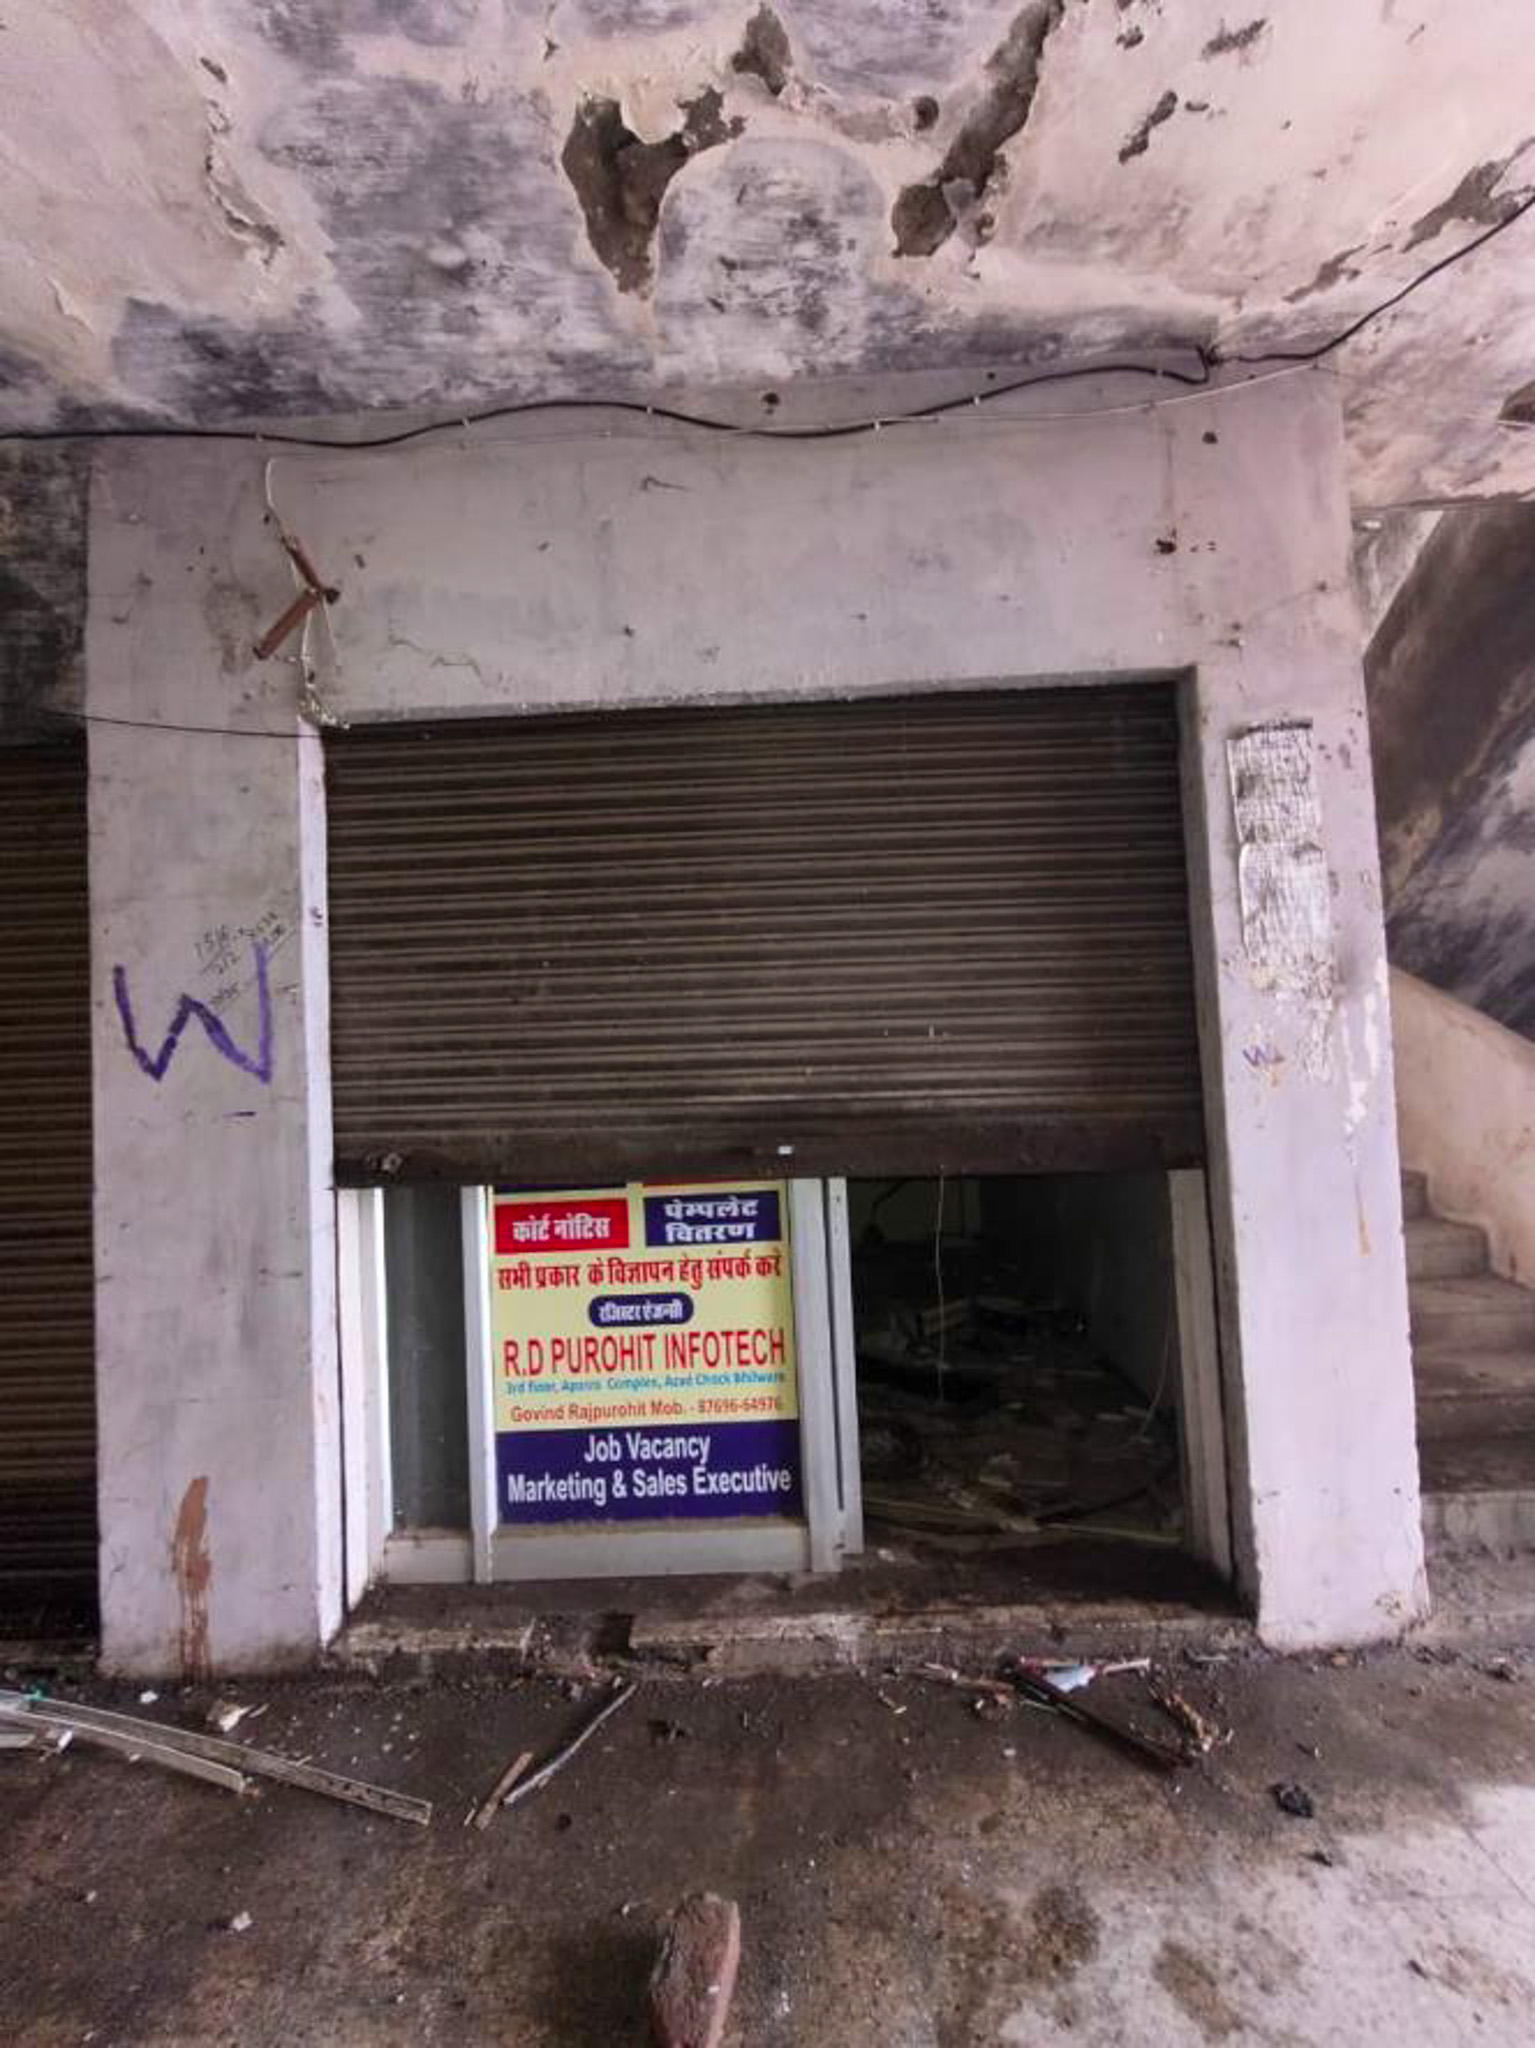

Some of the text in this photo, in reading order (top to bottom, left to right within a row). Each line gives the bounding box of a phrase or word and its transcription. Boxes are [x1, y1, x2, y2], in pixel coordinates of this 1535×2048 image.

[665, 1222, 755, 1243] वितरण
[498, 1261, 531, 1290] सभी
[535, 1265, 580, 1288] प्रकार
[587, 1257, 604, 1285] के
[607, 1257, 674, 1285] विज्ञापन
[678, 1253, 703, 1290] हेतु
[707, 1248, 751, 1280] संपर्क
[504, 1328, 786, 1376] R.D PUROHIT INFOTECH
[510, 1403, 565, 1423] Govind
[568, 1401, 647, 1423] Rajpurohit
[583, 1431, 711, 1466] Job Vacancy
[508, 1461, 793, 1508] Marketing & Sales Executive
